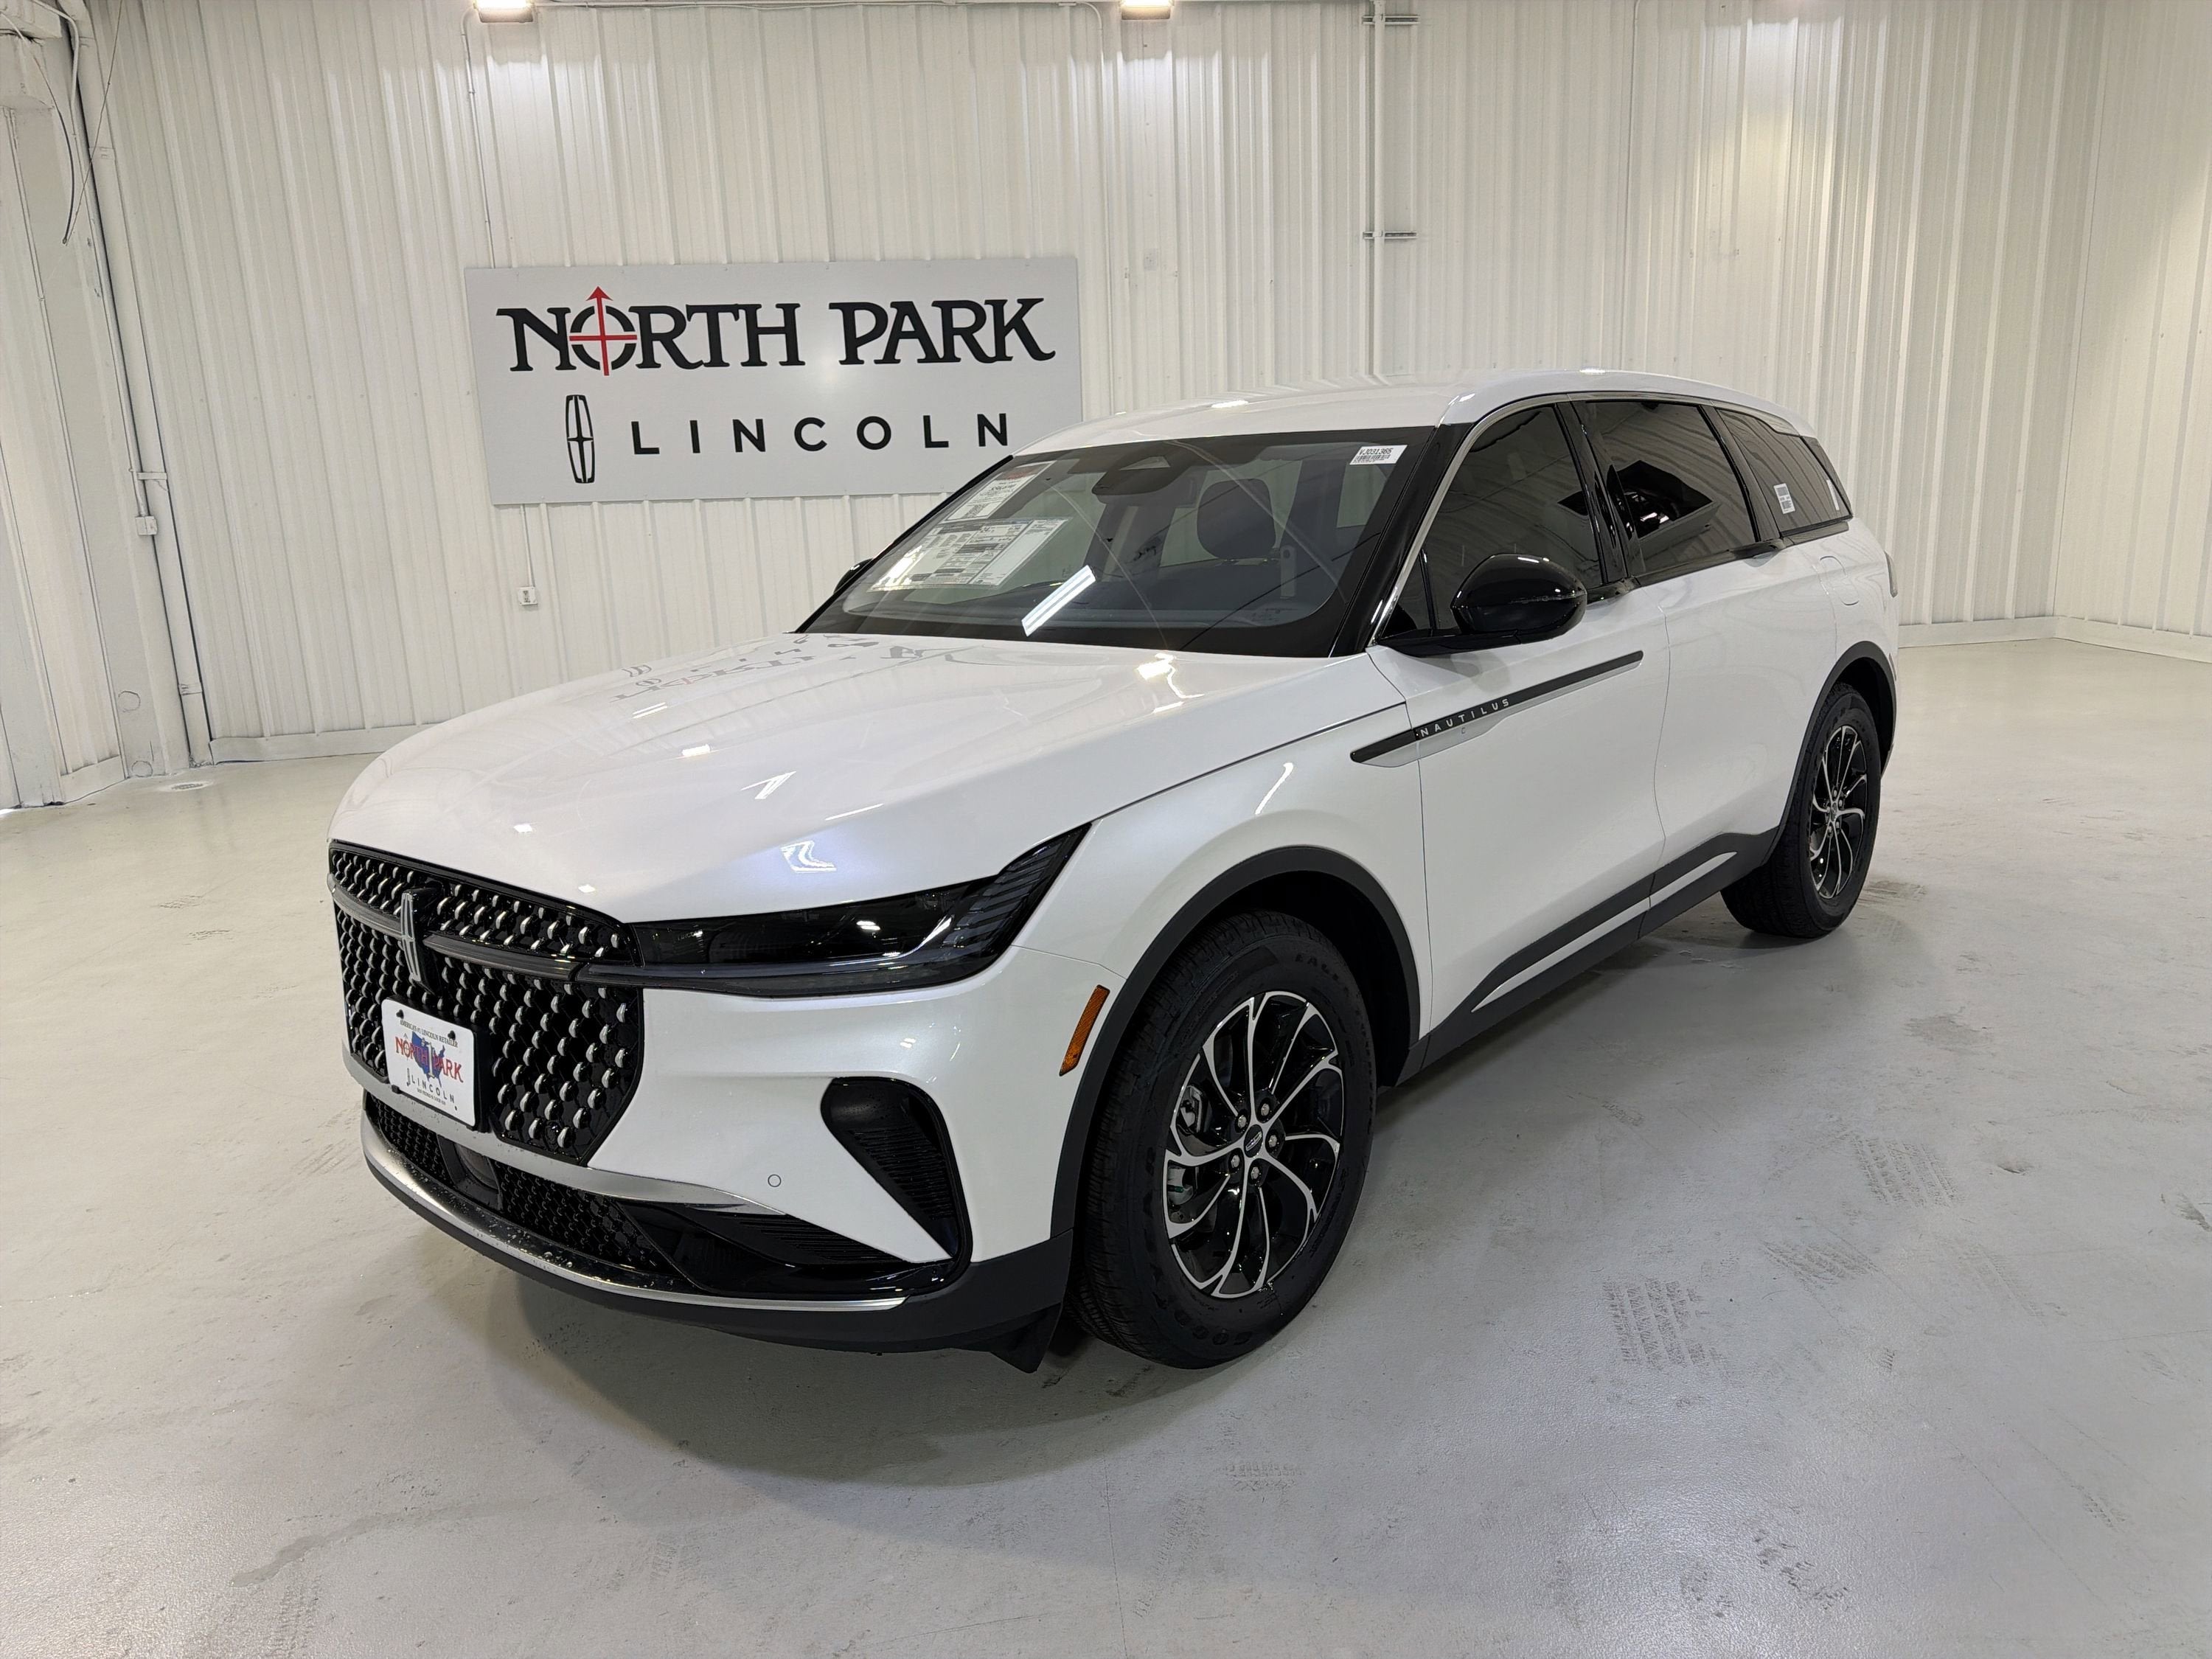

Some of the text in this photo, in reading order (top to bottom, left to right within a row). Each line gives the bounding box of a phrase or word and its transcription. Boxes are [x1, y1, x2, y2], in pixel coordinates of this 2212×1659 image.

[496, 298, 1056, 372] NORTH PARK
[632, 414, 1008, 455] LINCOLN
[1420, 698, 1510, 737] NAUTILUS
[421, 1028, 439, 1041] LINCOLN
[395, 1036, 464, 1083] NORTH PARK
[411, 1074, 455, 1104] LINCOLN
